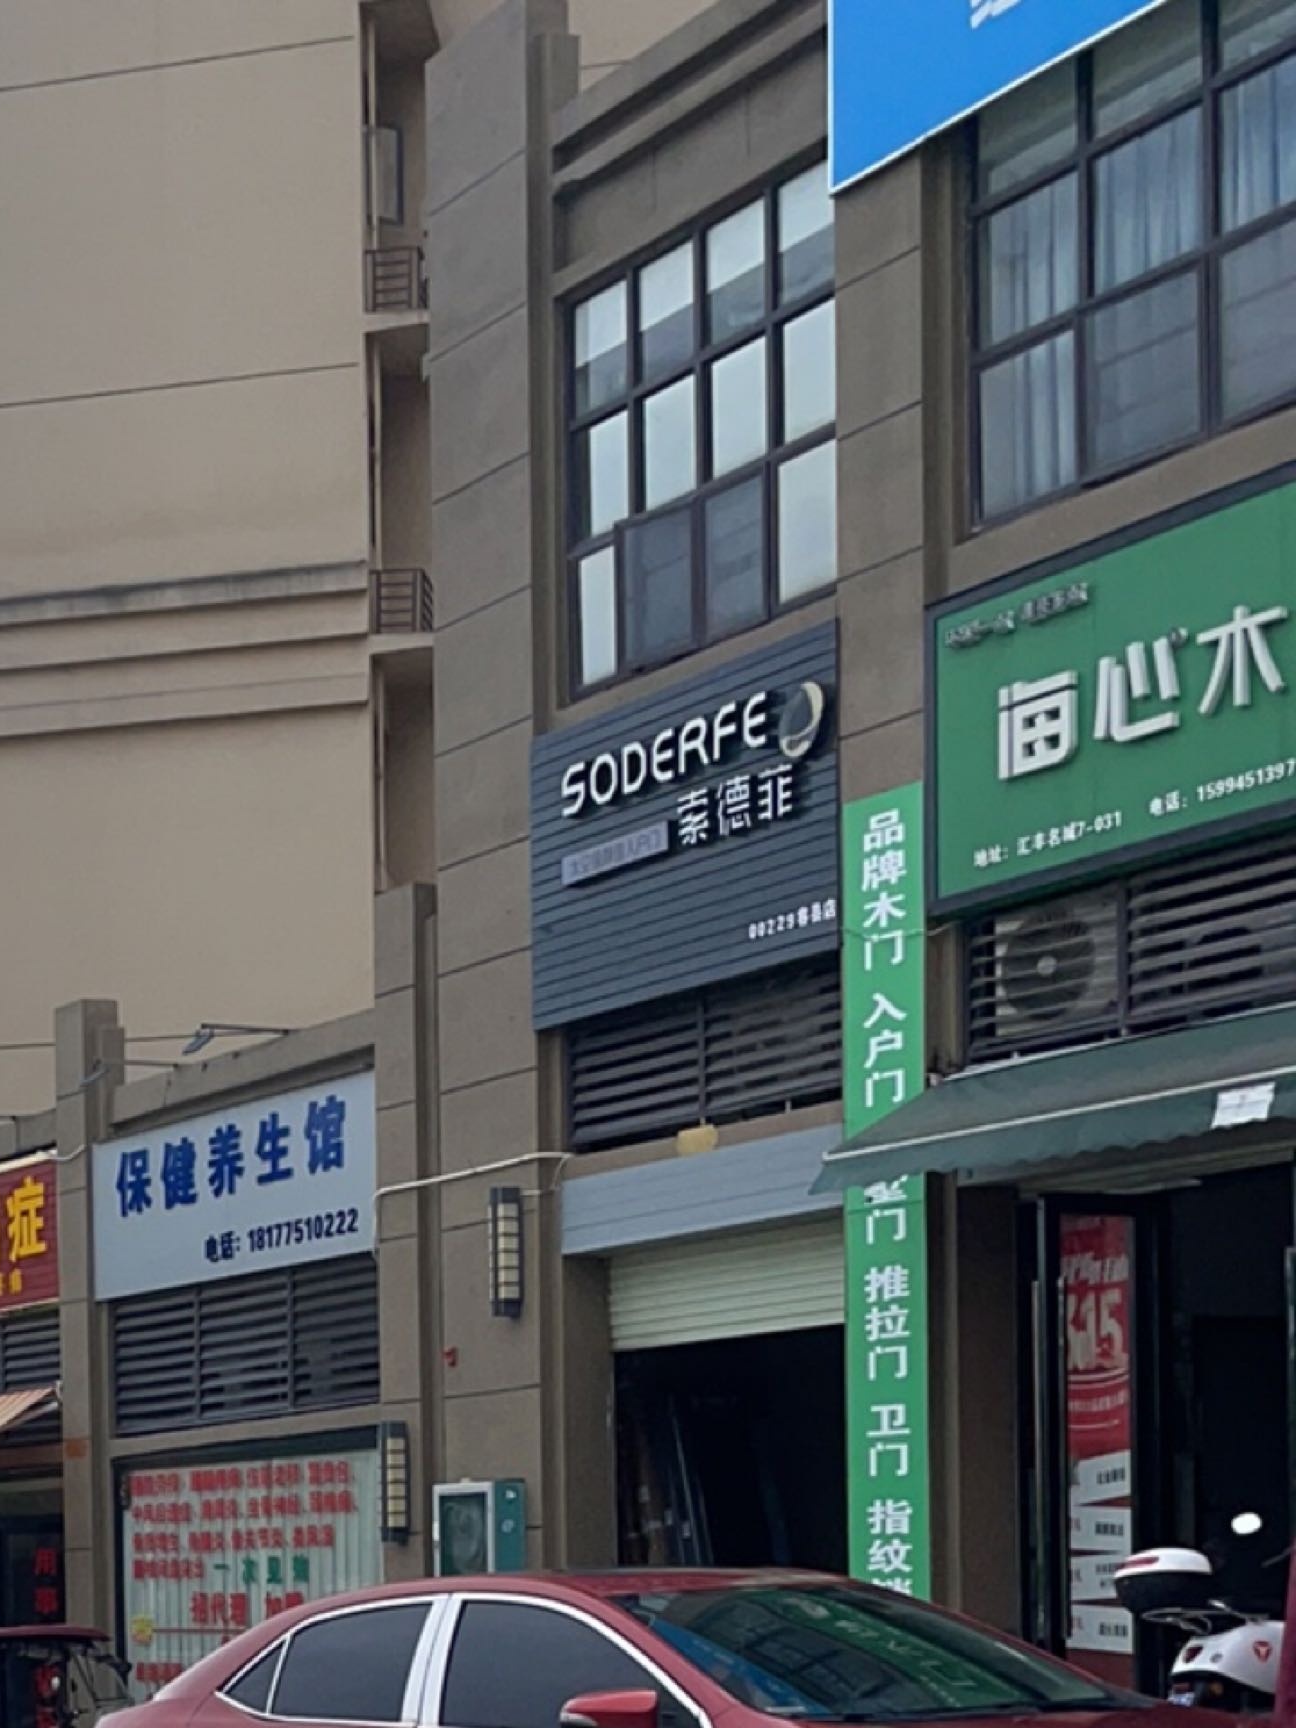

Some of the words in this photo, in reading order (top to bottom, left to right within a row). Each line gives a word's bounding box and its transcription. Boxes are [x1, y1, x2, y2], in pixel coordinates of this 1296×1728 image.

[561, 691, 767, 817] SODERFE
[862, 808, 907, 971] 品牌木门
[863, 993, 907, 1108] 入户门
[116, 1094, 346, 1218] 保健养生馆
[865, 1266, 911, 1381] 推拉门
[866, 1404, 911, 1477] 卫门
